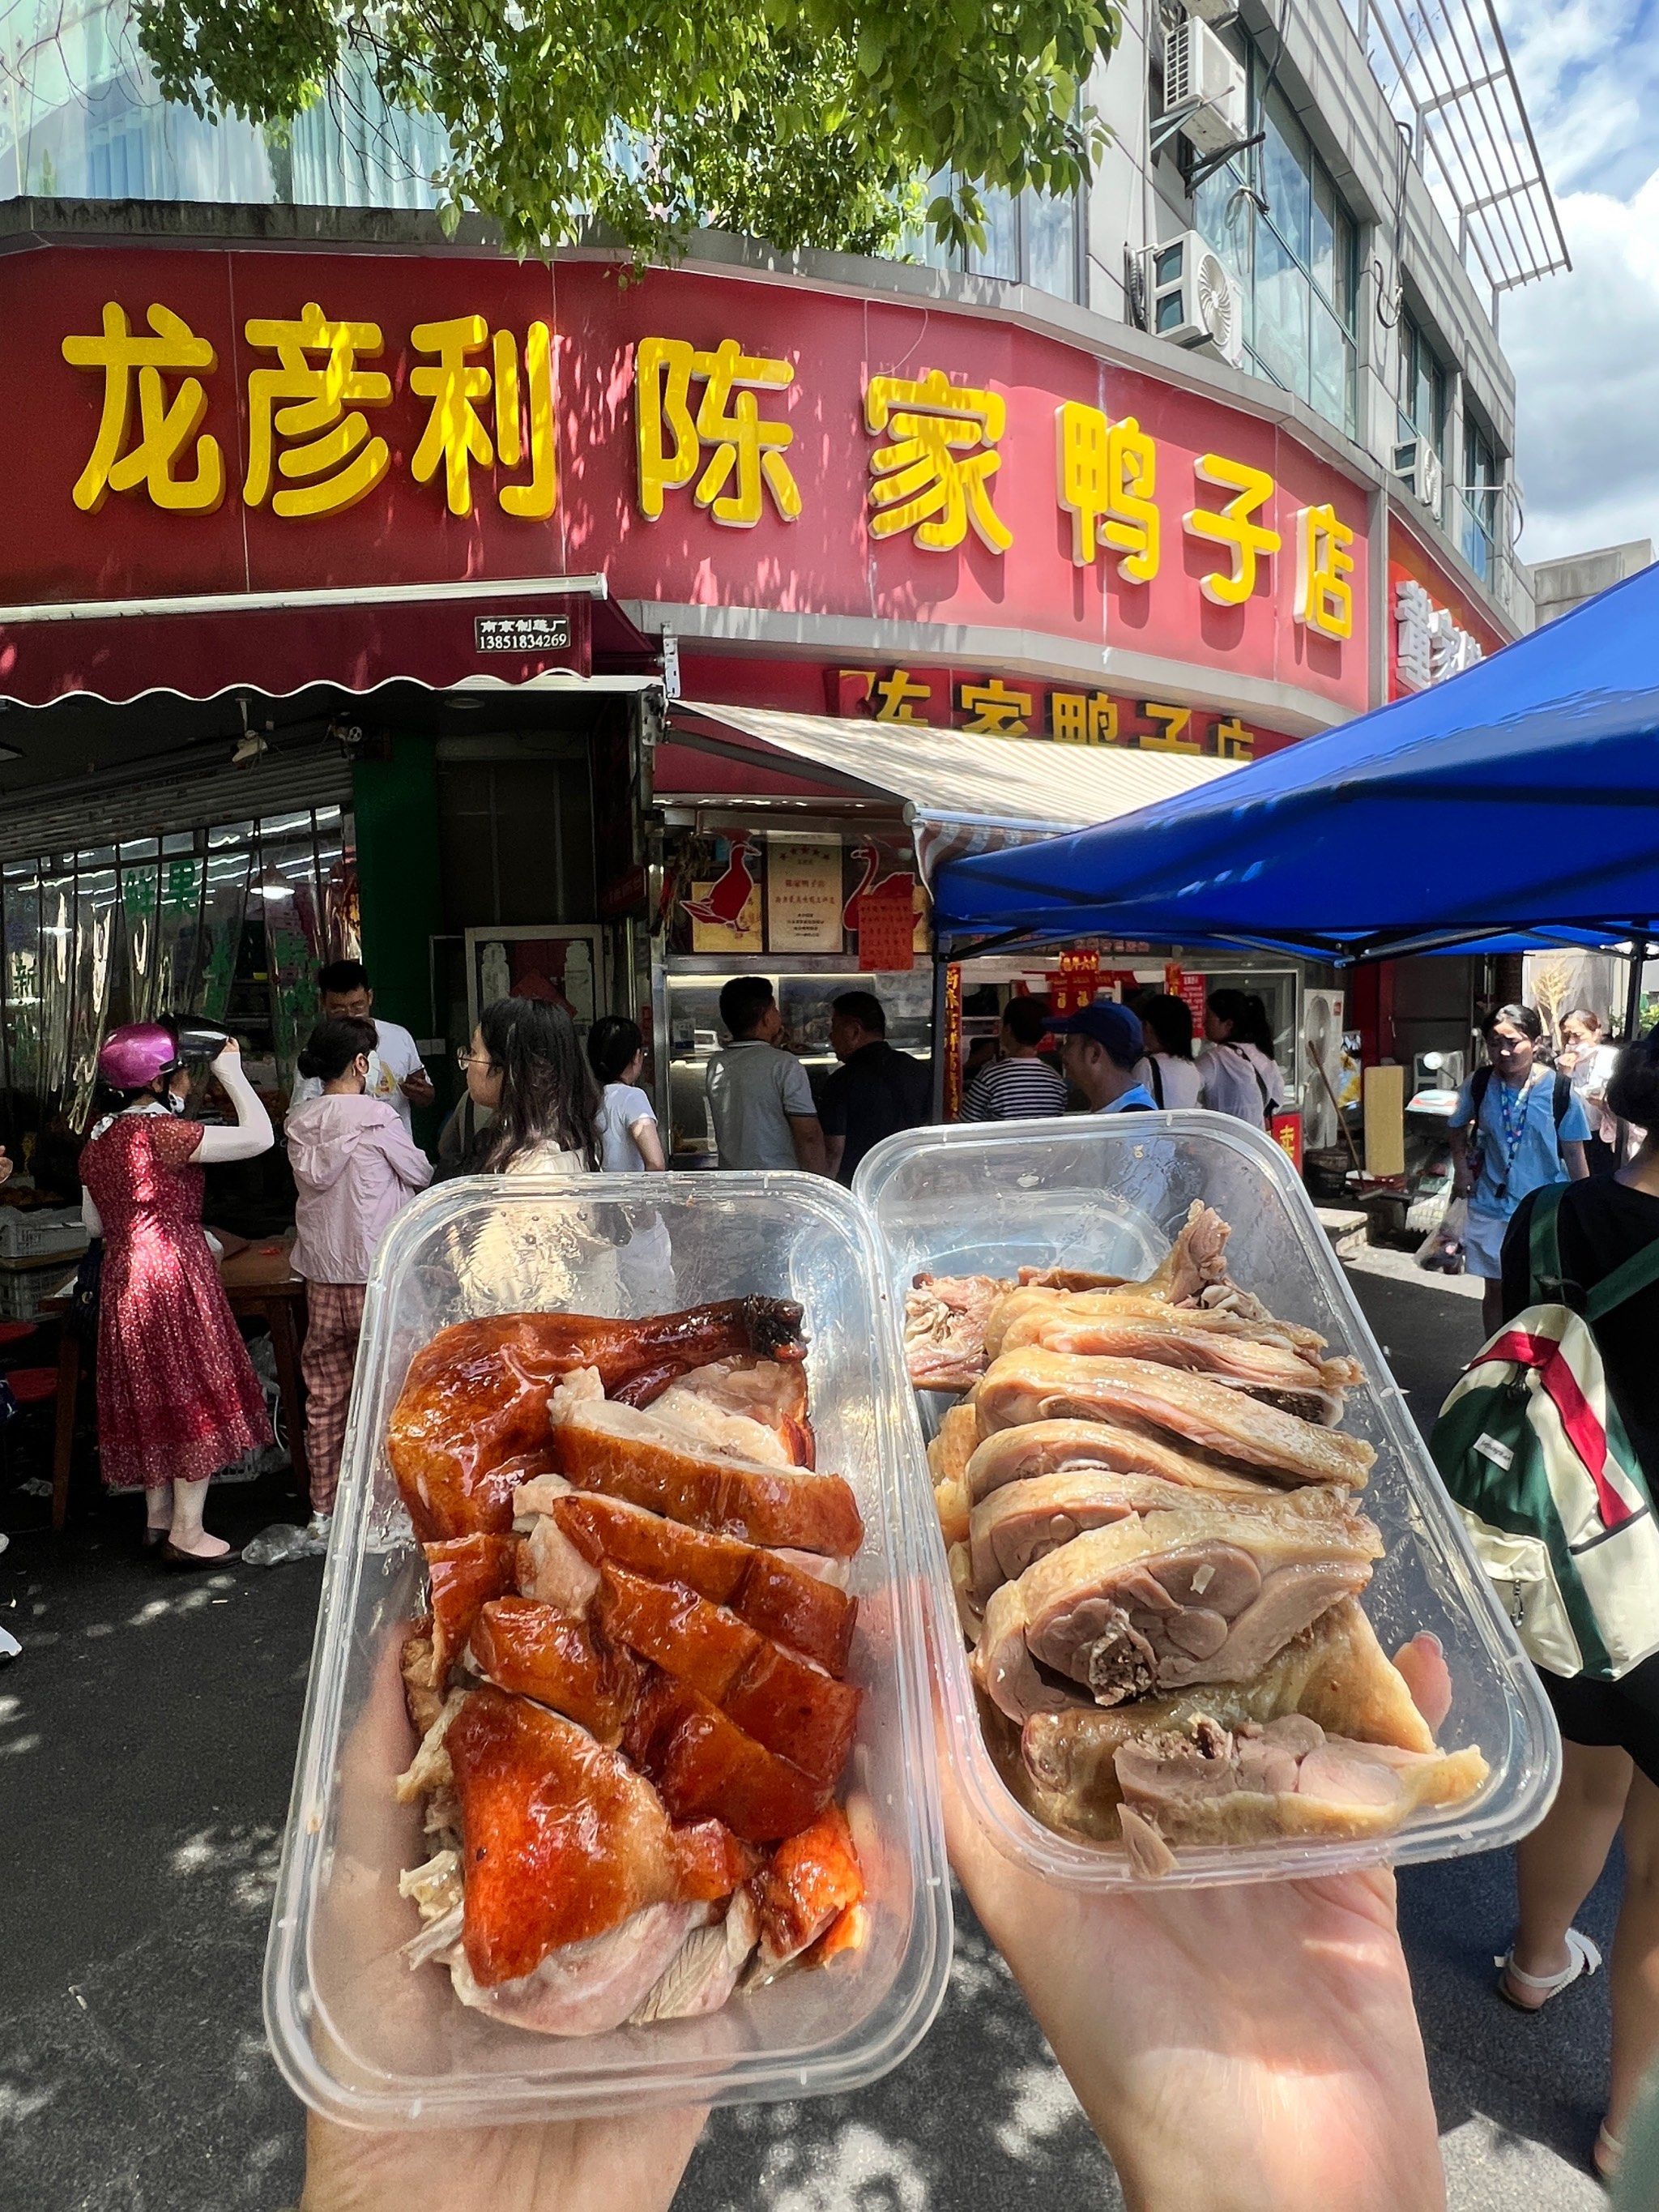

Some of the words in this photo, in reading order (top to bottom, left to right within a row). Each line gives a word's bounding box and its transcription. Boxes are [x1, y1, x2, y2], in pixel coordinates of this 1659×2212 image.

[62, 301, 1354, 642] 龙彦利陈家鸭子店
[480, 634, 566, 649] 13851834269
